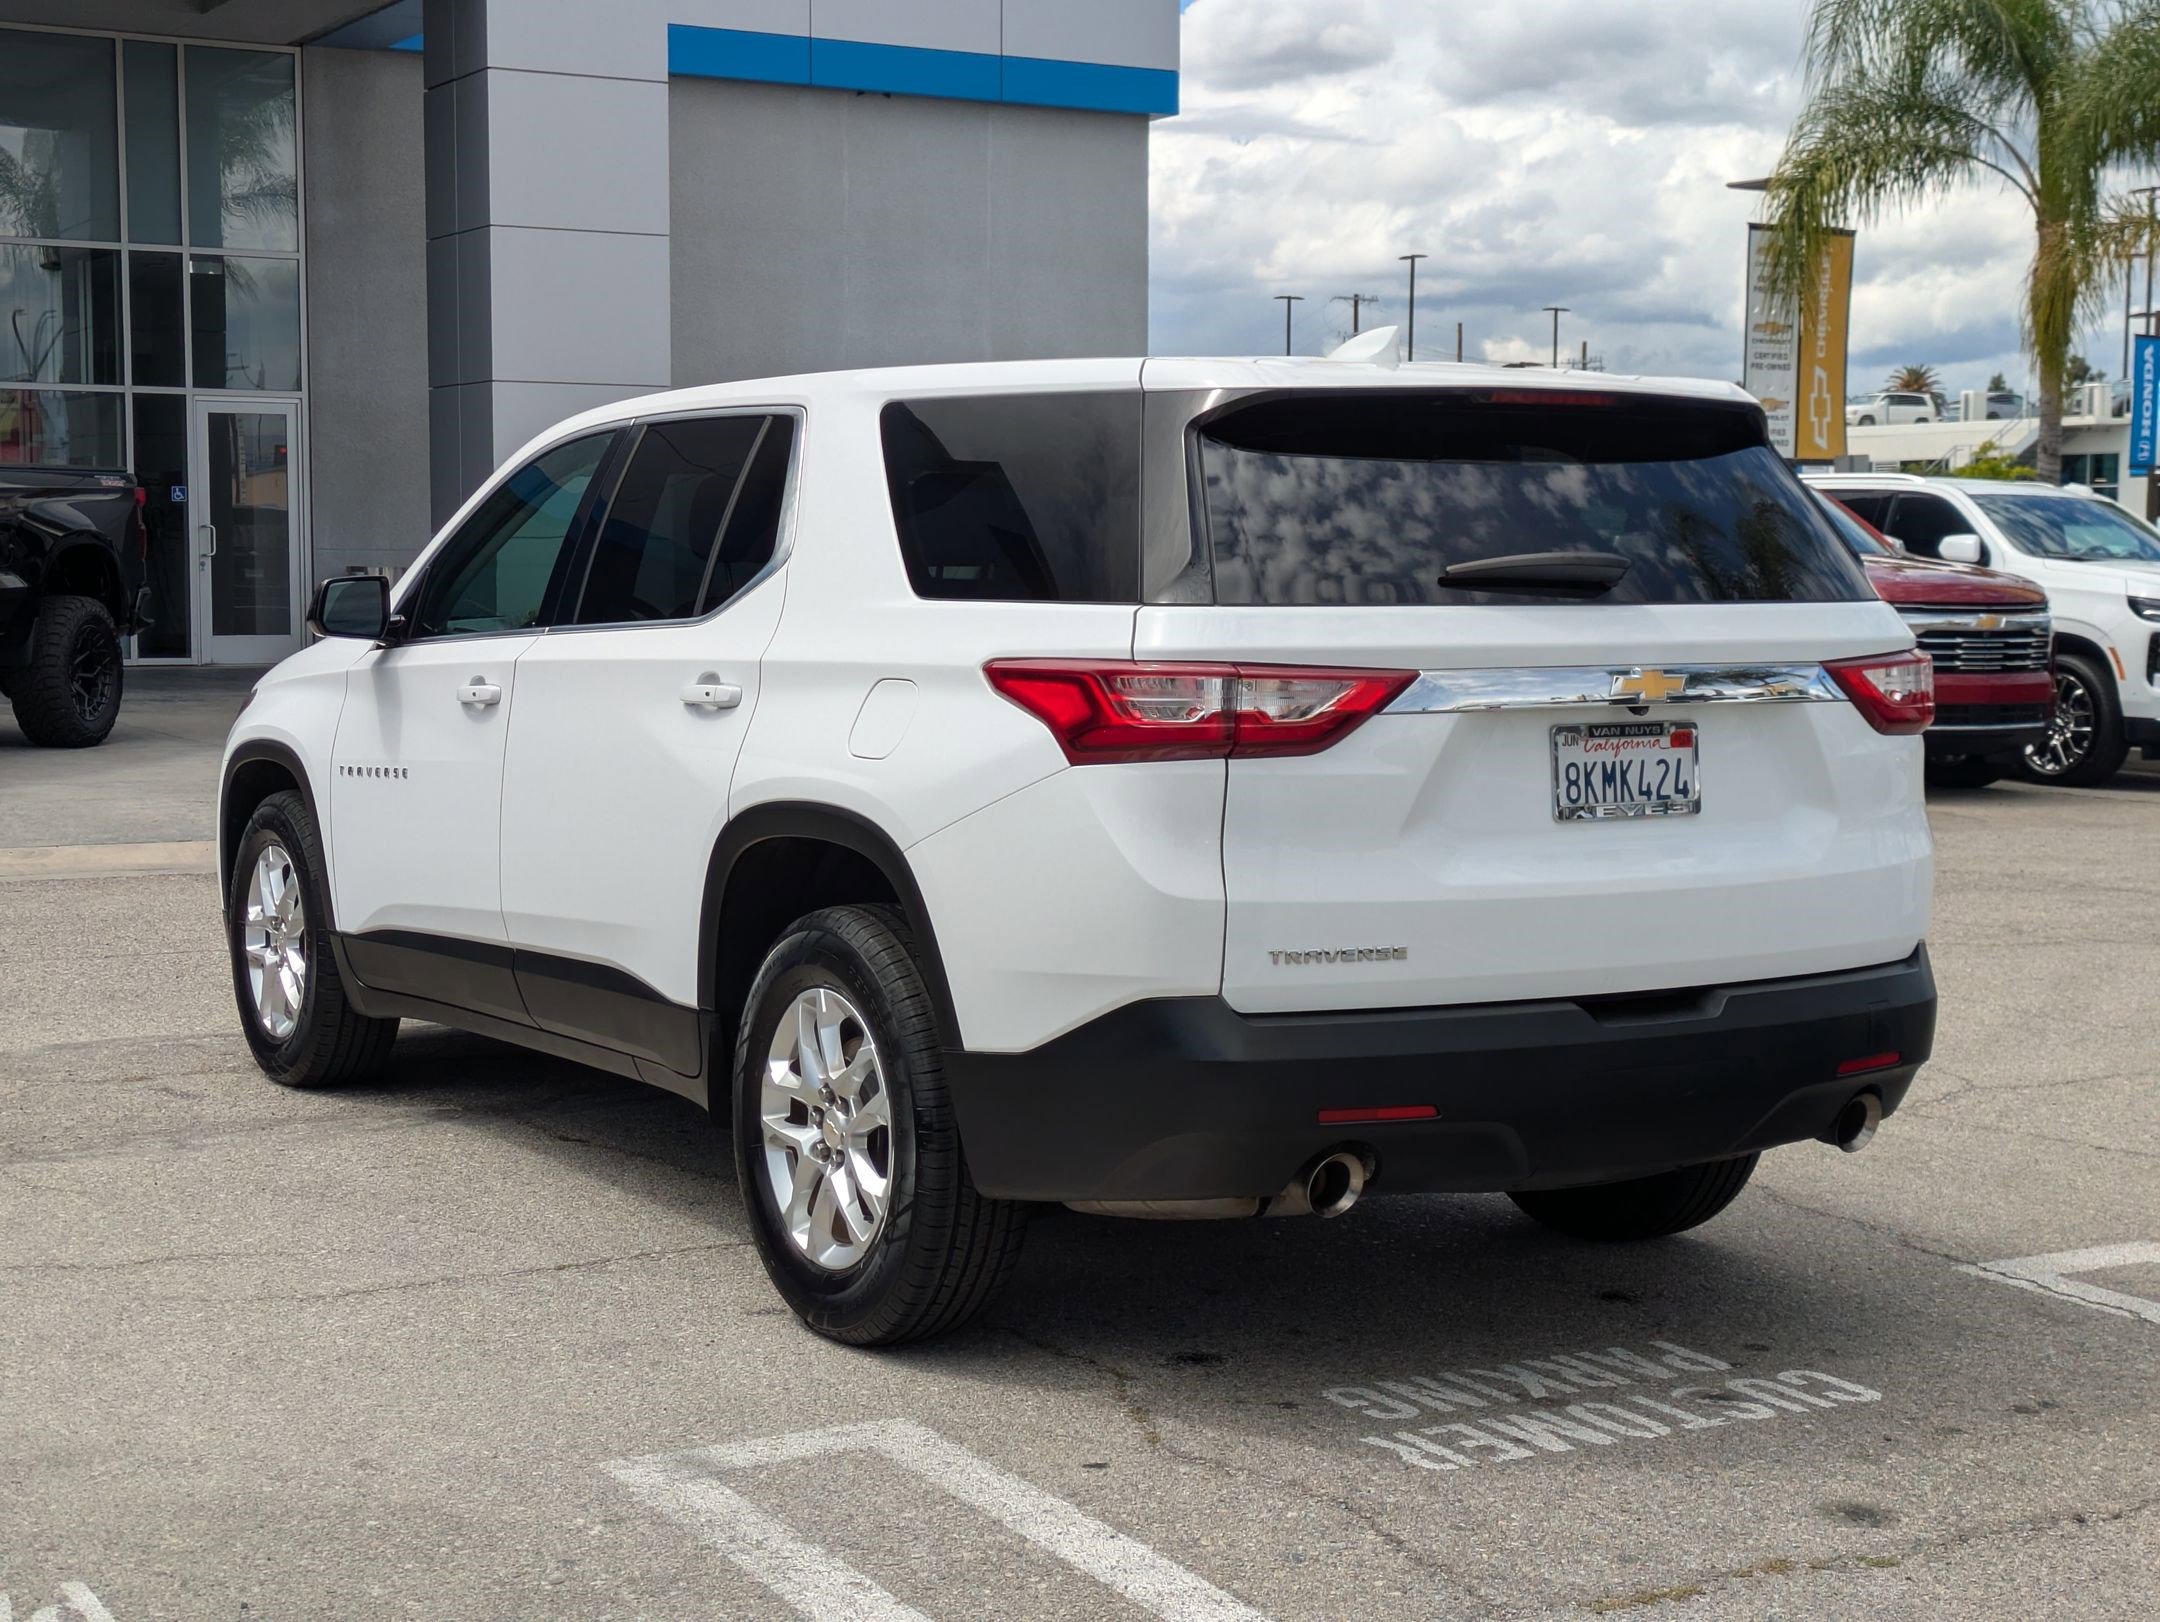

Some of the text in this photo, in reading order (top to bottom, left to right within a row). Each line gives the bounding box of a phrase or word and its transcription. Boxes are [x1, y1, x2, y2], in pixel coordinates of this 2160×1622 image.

[1753, 352, 1789, 361] CERTIFIED
[1750, 362, 1792, 372] PRE-OWNED
[2142, 345, 2154, 437] HONDA
[1592, 725, 1662, 736] VAN NUYS
[1583, 738, 1671, 758] California
[339, 765, 409, 780] TRAVERSE
[1565, 757, 1690, 804] 8KMK424
[1267, 946, 1408, 966] TRAVERSE
[1321, 1340, 1732, 1420] PARKING
[1359, 1368, 1883, 1471] CUSTOMER
